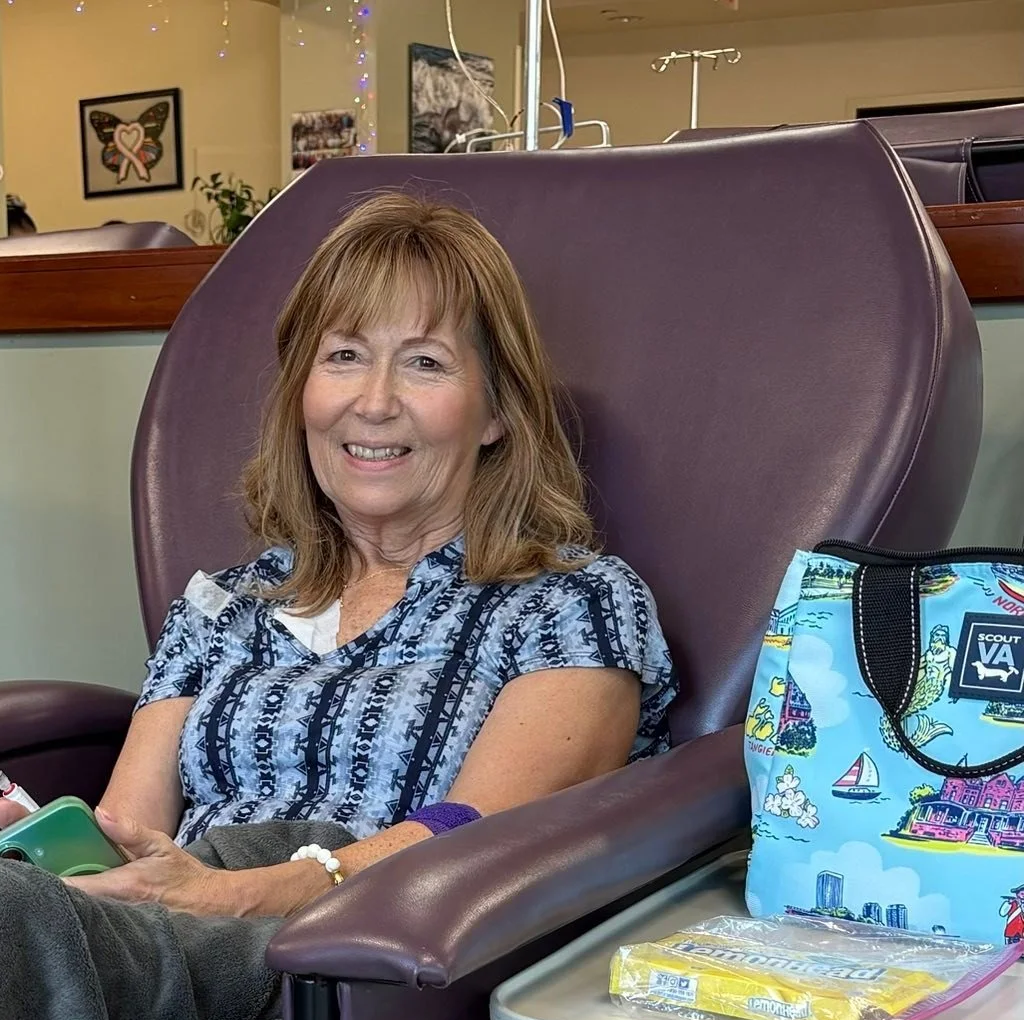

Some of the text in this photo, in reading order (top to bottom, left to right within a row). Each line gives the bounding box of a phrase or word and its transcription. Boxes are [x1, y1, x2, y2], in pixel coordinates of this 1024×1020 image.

[992, 596, 1024, 617] NOR
[977, 633, 1022, 644] SCOUT
[978, 641, 1015, 666] VA
